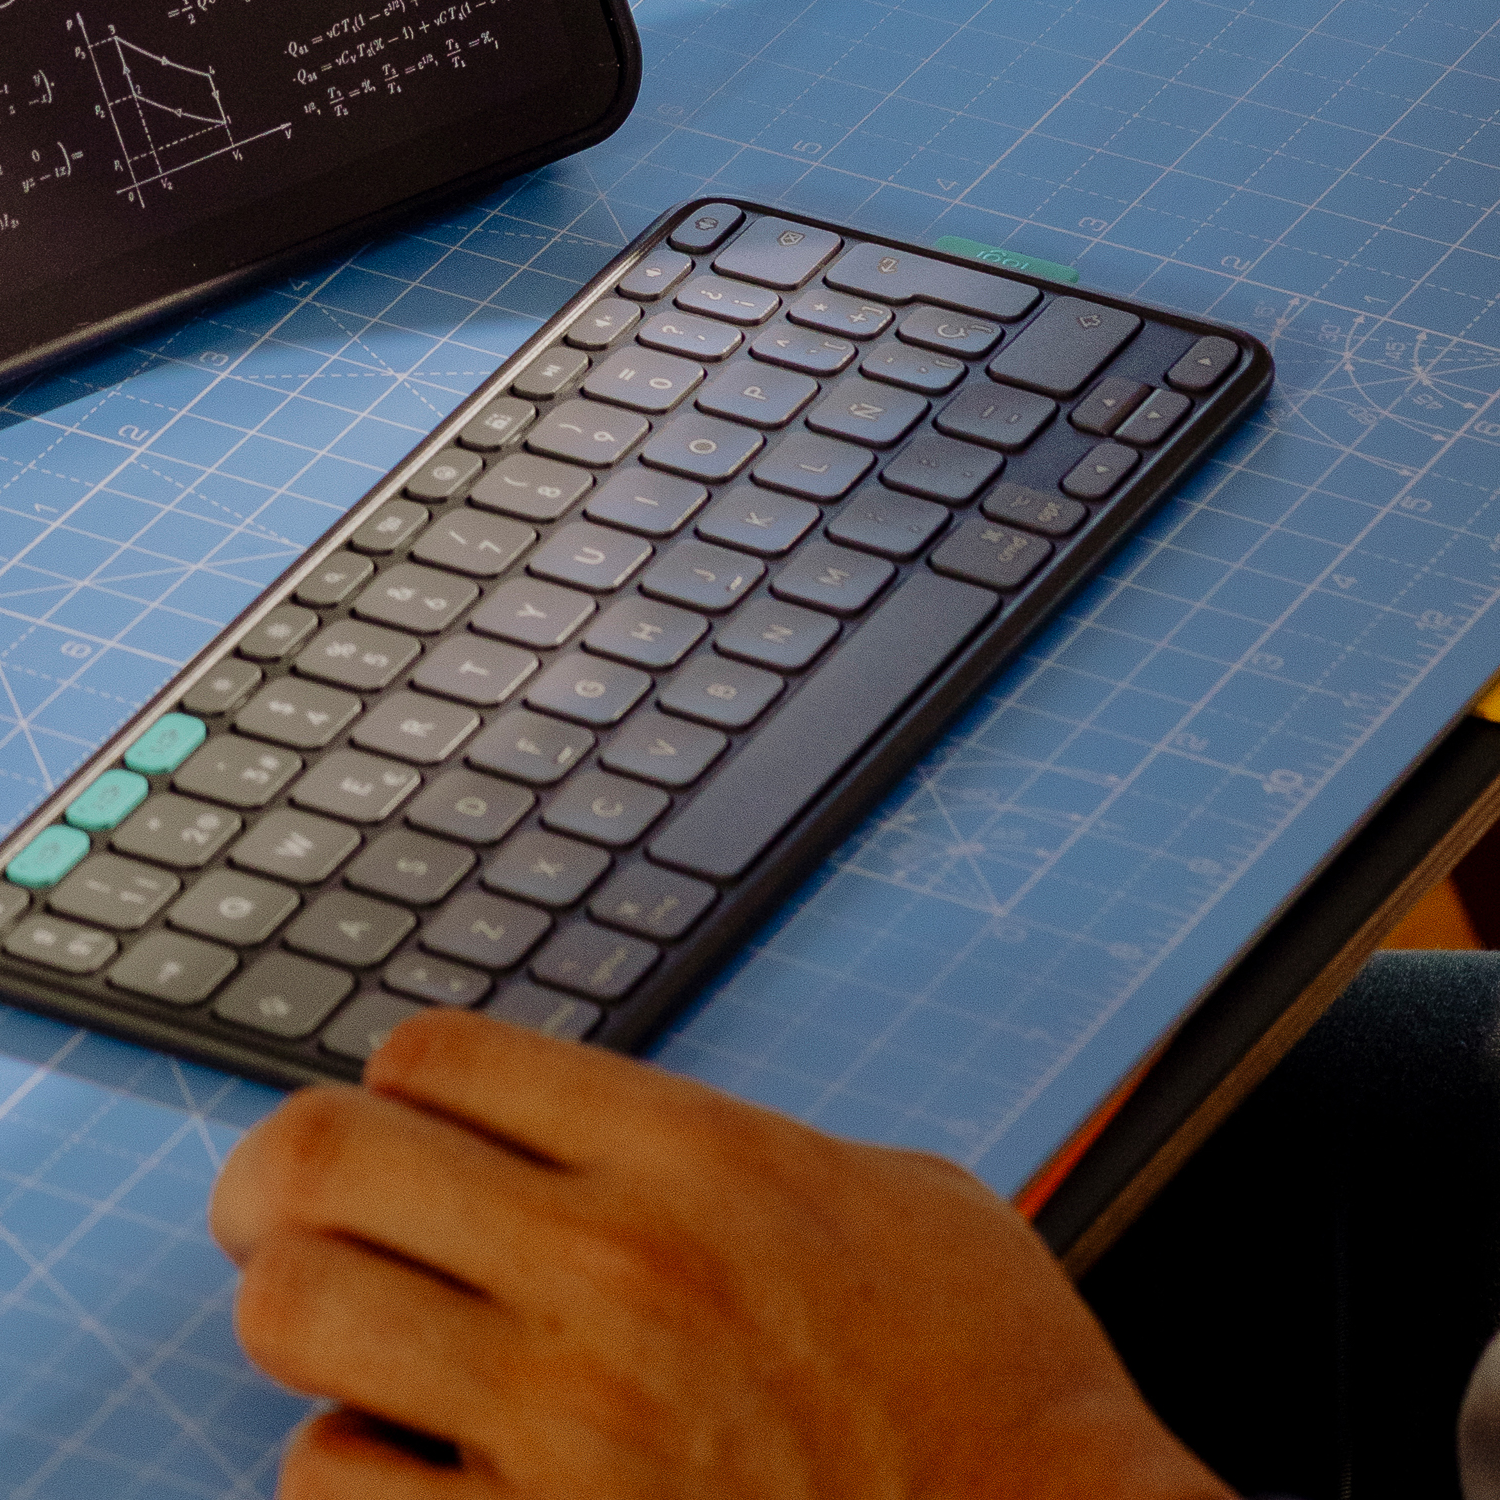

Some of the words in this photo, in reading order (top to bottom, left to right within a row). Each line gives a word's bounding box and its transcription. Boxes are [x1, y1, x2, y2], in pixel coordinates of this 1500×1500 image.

[792, 139, 824, 156] 5
[935, 174, 961, 193] 4
[1077, 214, 1109, 234] 3
[1220, 253, 1252, 272] 2
[199, 350, 230, 368] 3
[743, 385, 768, 401] P
[849, 401, 885, 421] Ñ
[118, 423, 152, 442] 2
[745, 511, 774, 529] K
[573, 546, 606, 566] U
[693, 567, 717, 582] J
[1330, 573, 1359, 590] 4
[515, 602, 548, 619] Y
[631, 621, 664, 643] H
[60, 639, 93, 660] 6
[458, 659, 490, 677] T
